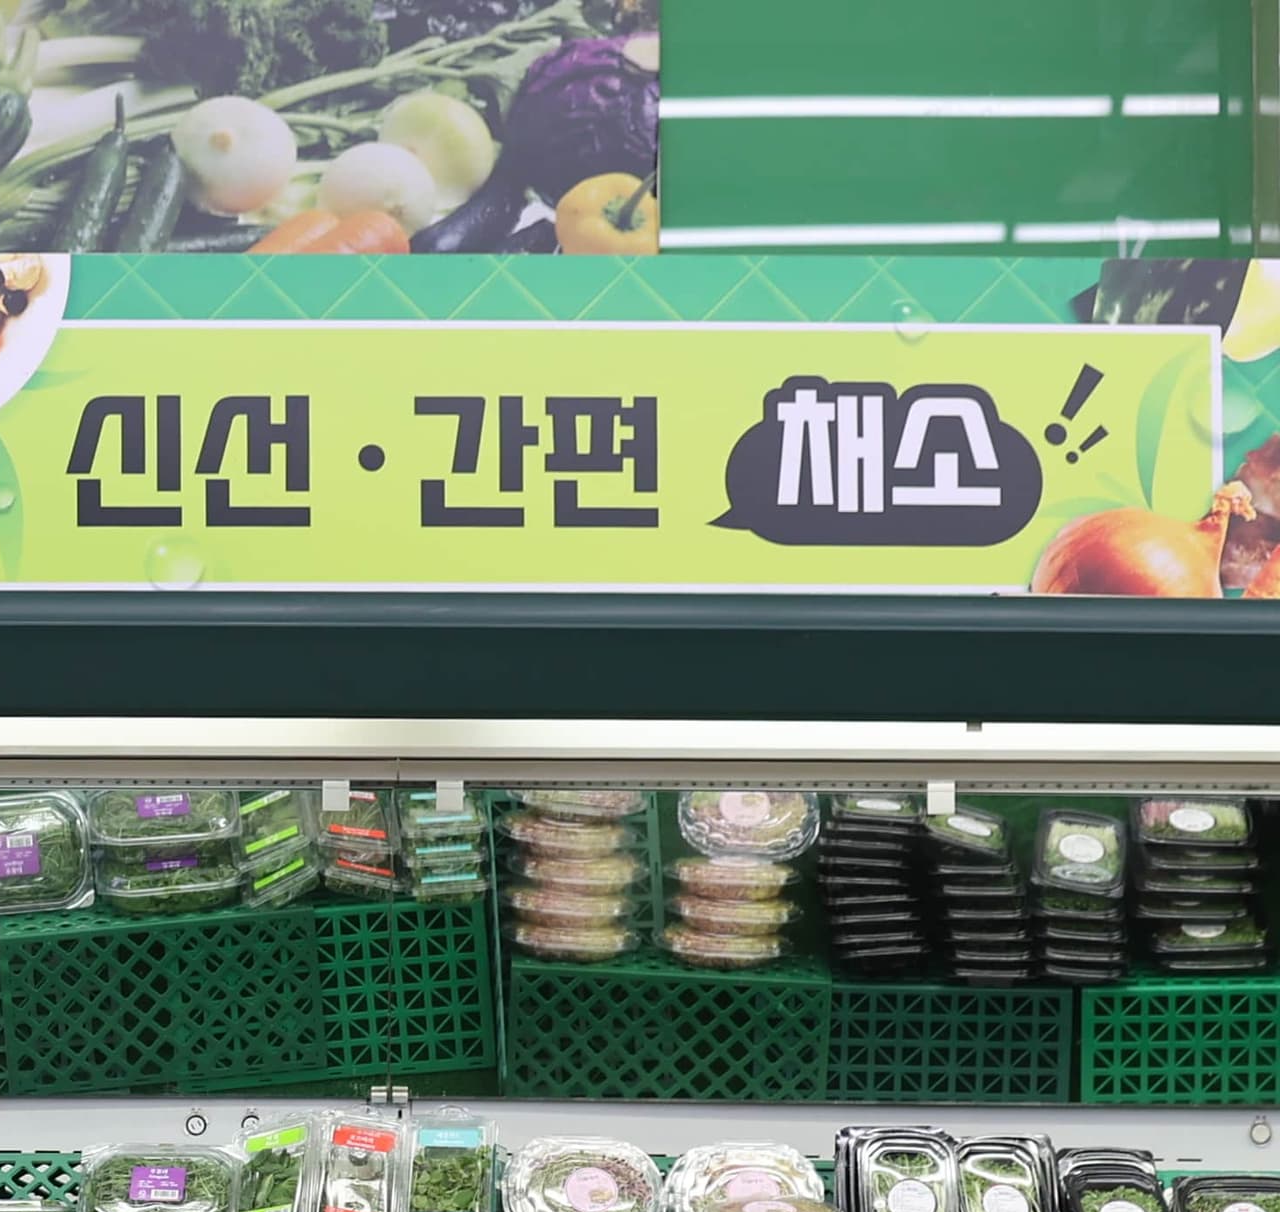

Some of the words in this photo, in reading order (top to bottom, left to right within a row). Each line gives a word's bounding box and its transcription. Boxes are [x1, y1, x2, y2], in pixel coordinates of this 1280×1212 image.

[66, 395, 311, 527] 신선
[414, 396, 659, 528] 간편
[777, 389, 1001, 512] 채소
